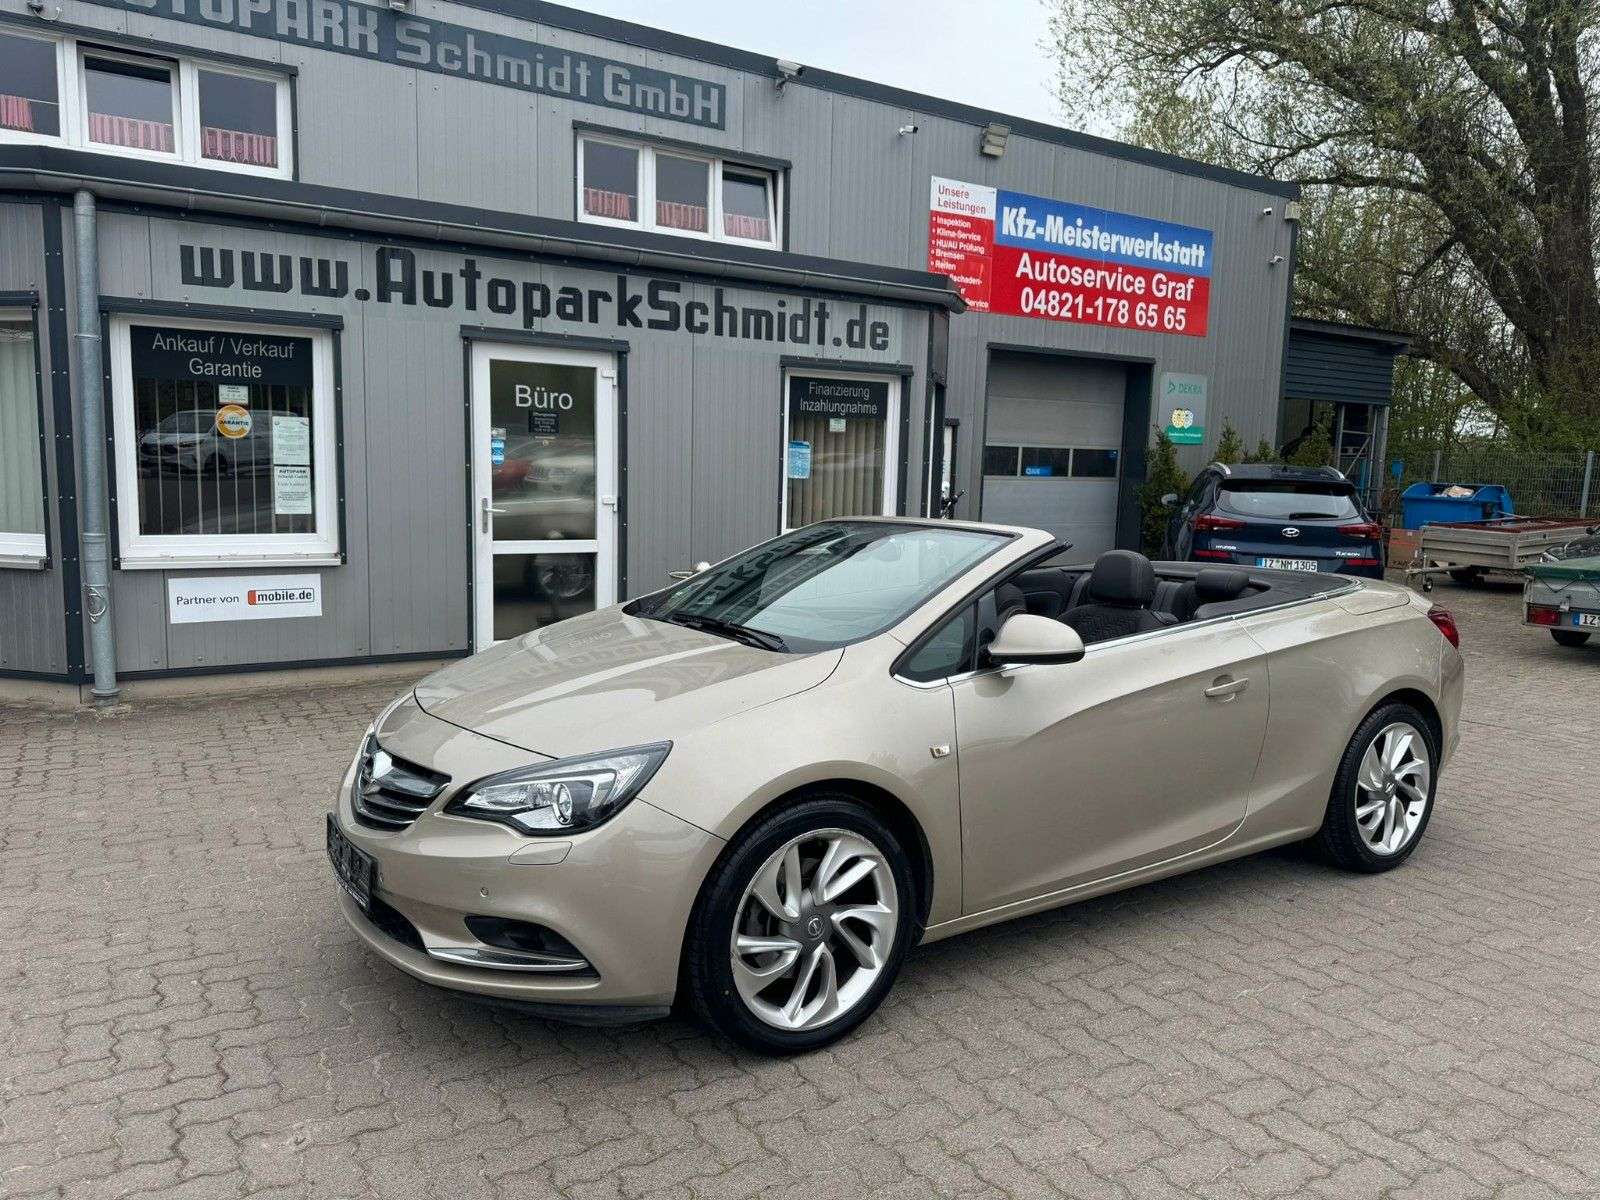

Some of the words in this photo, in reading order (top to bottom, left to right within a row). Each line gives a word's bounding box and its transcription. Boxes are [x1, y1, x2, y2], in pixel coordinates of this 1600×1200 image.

[396, 20, 591, 97] Schmidt
[604, 64, 719, 124] GmbH
[938, 184, 970, 199] Unsere
[938, 197, 986, 215] Leistungen
[937, 216, 971, 229] Inspektion
[936, 228, 982, 242] Klima-Service
[1002, 206, 1205, 268] Kfz-Meisterwerkstatt
[935, 248, 965, 260] Bremsen
[936, 239, 958, 249] HU/AU
[959, 241, 985, 255] Prüfung
[935, 259, 956, 270] Reifen
[1016, 252, 1146, 295] Autoservice
[1152, 273, 1195, 301] Graf
[181, 245, 889, 351] www.AutoparkSchmidt.de
[1020, 287, 1129, 324] 04821-178
[1135, 302, 1158, 328] 65
[1164, 305, 1186, 331] 65
[152, 332, 215, 354] Ankauf
[219, 337, 226, 354] /
[230, 338, 295, 359] Verkauf
[189, 357, 262, 378] Garantie
[515, 384, 573, 410] Büro
[808, 381, 870, 400] Finanzierung
[800, 398, 878, 416] Inzahlungnahme
[1263, 558, 1274, 568] IZ
[1280, 560, 1293, 570] NM
[1294, 560, 1317, 571] 1305
[176, 595, 216, 605] Partner
[257, 590, 312, 602] mobile.de
[1582, 615, 1597, 626] IZ
